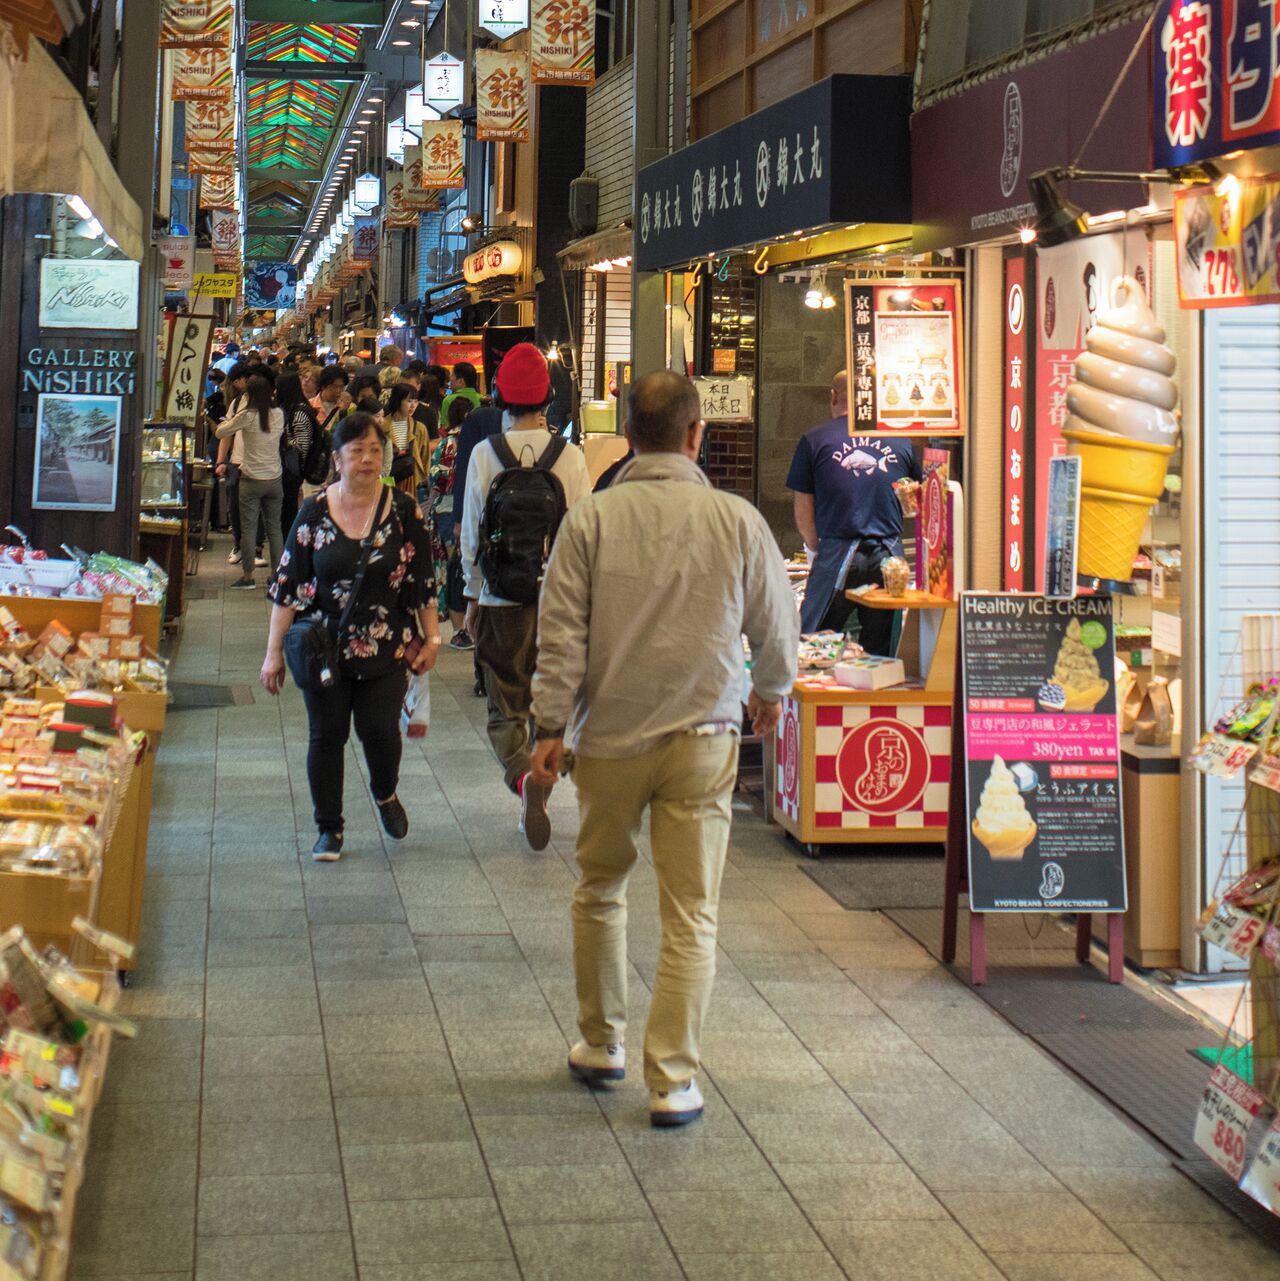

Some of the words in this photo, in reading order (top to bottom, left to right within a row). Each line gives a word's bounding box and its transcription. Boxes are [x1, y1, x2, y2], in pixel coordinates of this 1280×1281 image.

[171, 9, 205, 17] NISHIKI
[540, 46, 573, 55] NISHIKI
[180, 66, 211, 74] NISHIKI
[480, 67, 523, 118] 錦
[425, 132, 460, 172] 錦
[777, 125, 822, 196] 錦大丸
[708, 160, 742, 217] 錦大丸
[654, 184, 682, 236] 錦大丸
[854, 295, 871, 325] 京都
[28, 348, 135, 368] GALLERY
[709, 384, 730, 395] 本日
[856, 331, 873, 421] 豆菓子専門店
[832, 436, 898, 463] DAIMARU
[1010, 356, 1022, 594] 京のおまめ
[965, 598, 1025, 618] Healthy
[1029, 598, 1052, 614] ICE
[1056, 599, 1112, 616] CREAM
[971, 719, 1115, 732] 豆専門店の和風ジェラート
[876, 729, 905, 771] 京の
[1032, 742, 1083, 760] 380yen
[1089, 747, 1104, 756] TAX
[1036, 781, 1116, 796] とうふアイス
[1213, 1120, 1244, 1164] 880
